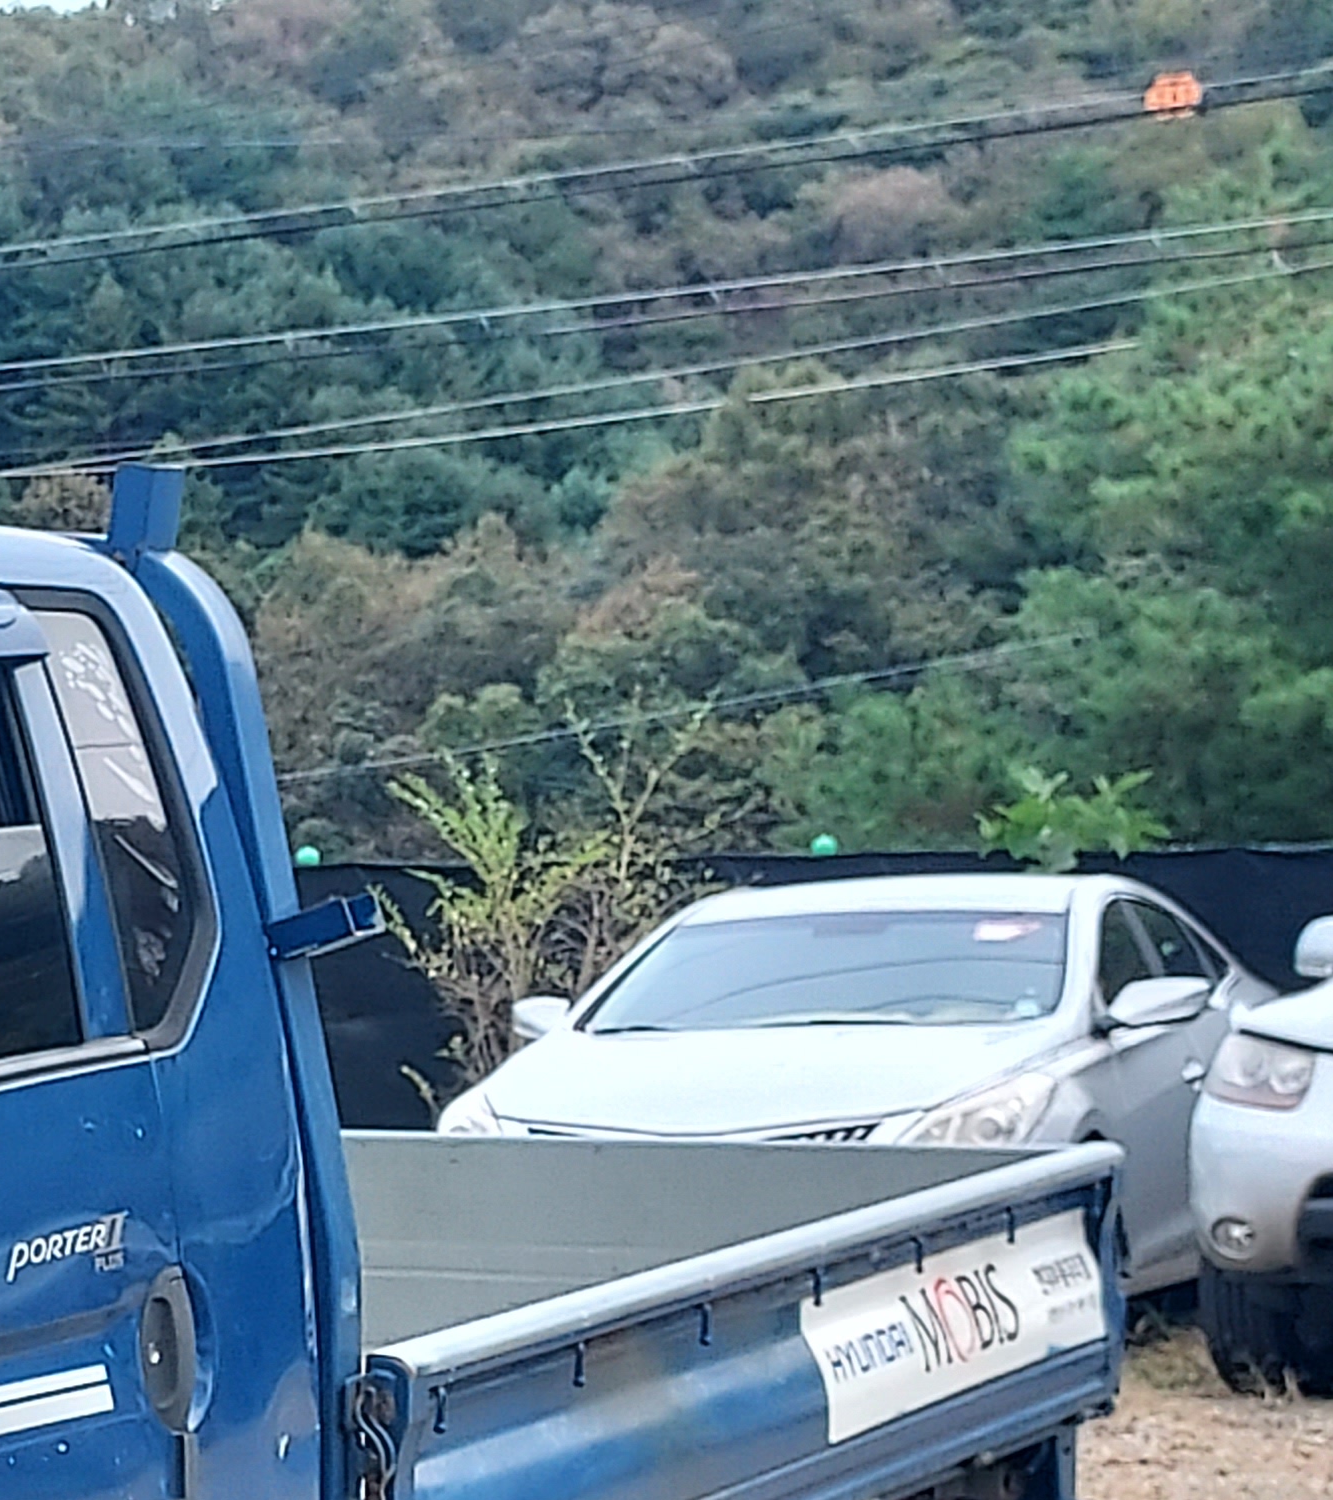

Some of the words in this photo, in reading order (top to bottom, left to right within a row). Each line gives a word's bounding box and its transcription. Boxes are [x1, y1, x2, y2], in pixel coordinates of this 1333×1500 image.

[5, 1222, 107, 1284] PORTER
[825, 1321, 915, 1385] HYUNDAI
[898, 1262, 1021, 1374] MOBIS
